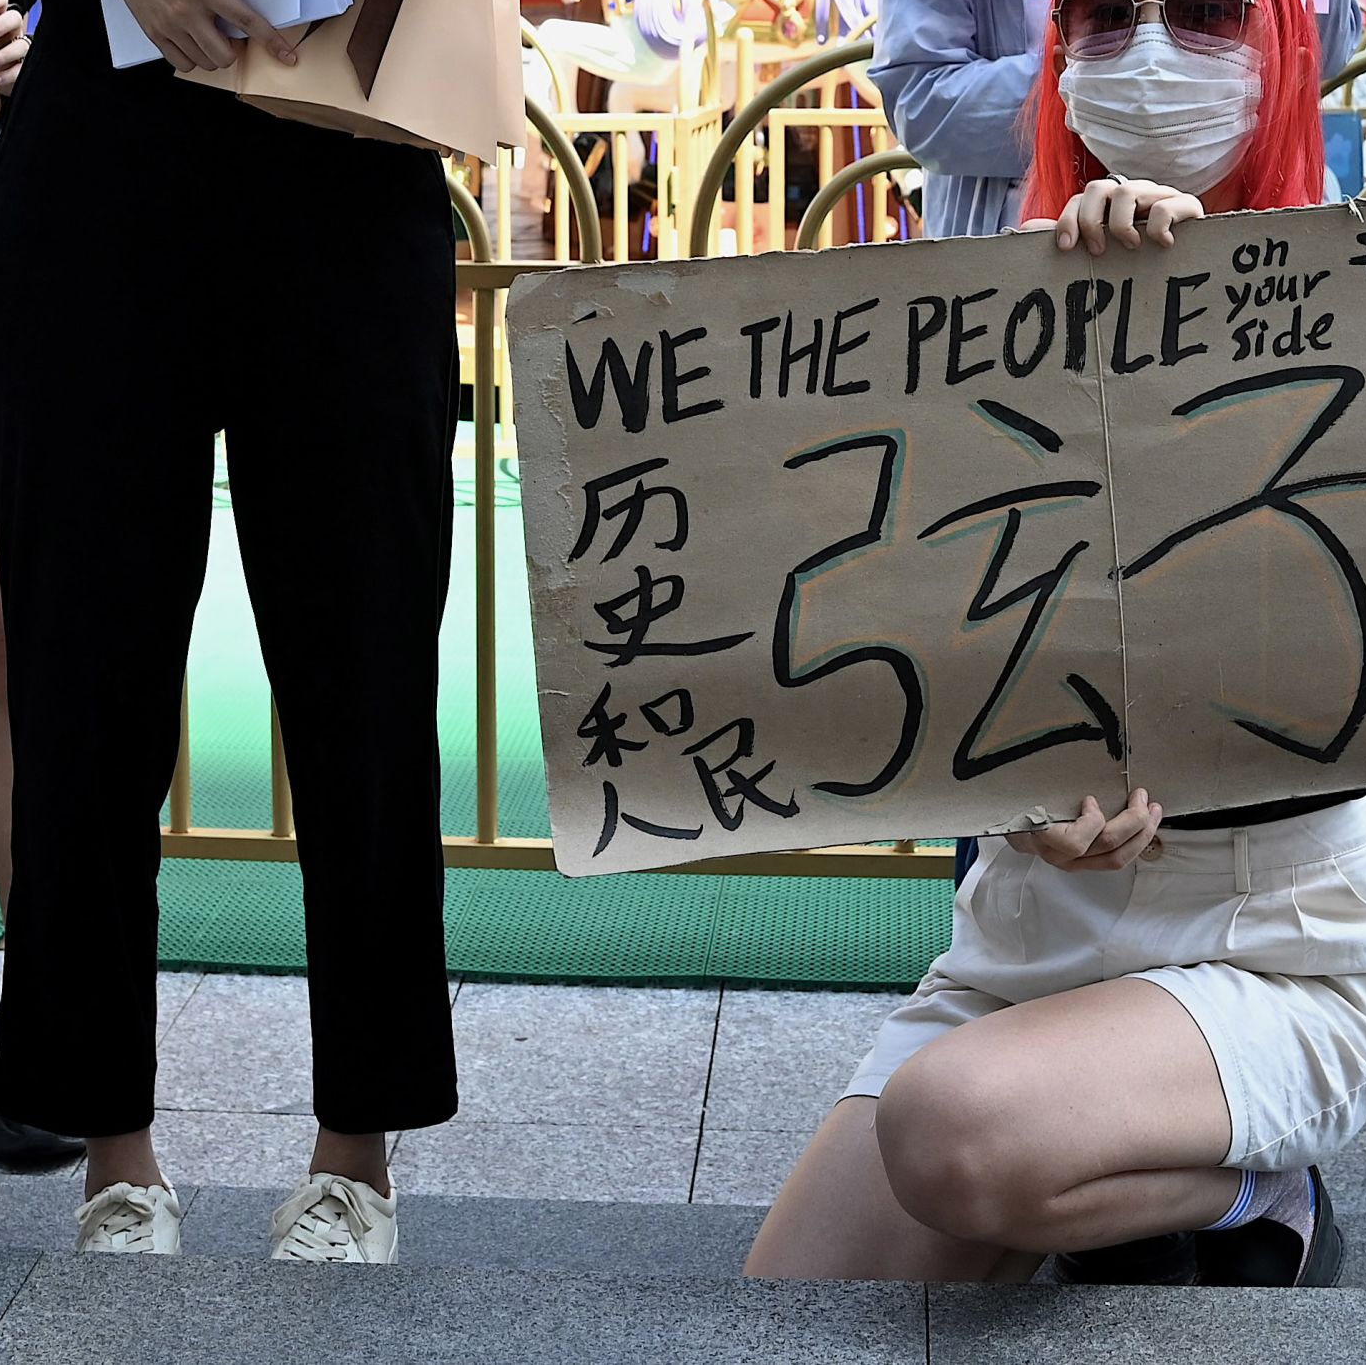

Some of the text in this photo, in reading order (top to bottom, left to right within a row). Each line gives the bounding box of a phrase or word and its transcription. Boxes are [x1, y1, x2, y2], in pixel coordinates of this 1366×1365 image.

[1231, 237, 1290, 275] on
[1224, 269, 1331, 324] your
[566, 272, 1213, 434] WE THE PEOPLE
[1231, 305, 1335, 361] side
